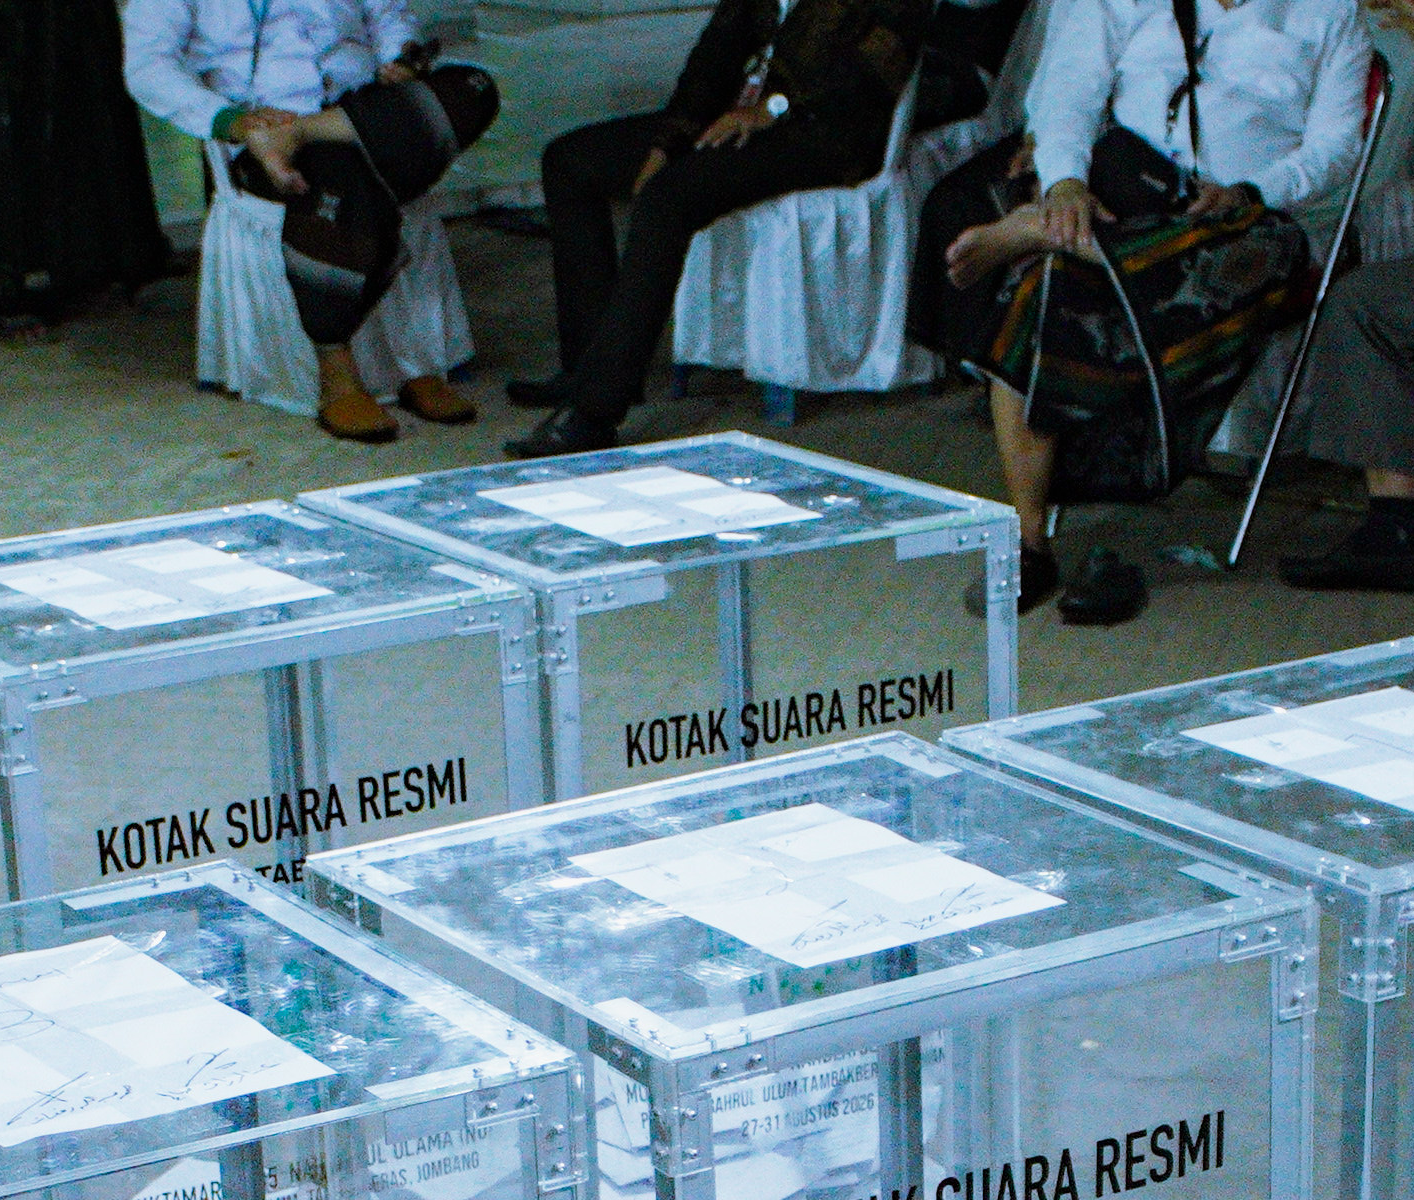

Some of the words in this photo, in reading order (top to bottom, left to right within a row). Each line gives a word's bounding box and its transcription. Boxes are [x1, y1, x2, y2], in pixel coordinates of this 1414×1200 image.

[627, 707, 730, 768] KOTAK
[740, 687, 847, 748] SUARA
[857, 668, 955, 729] RESMI
[96, 808, 216, 876] KOTAK
[226, 783, 347, 850] SUARA
[357, 757, 469, 823] RESMI
[804, 1061, 879, 1096] TAMBAKBER
[741, 1115, 780, 1137] 27-31
[843, 1092, 875, 1114] 2026
[417, 1151, 480, 1184] JOMBANG
[1095, 1110, 1226, 1200] RESMI
